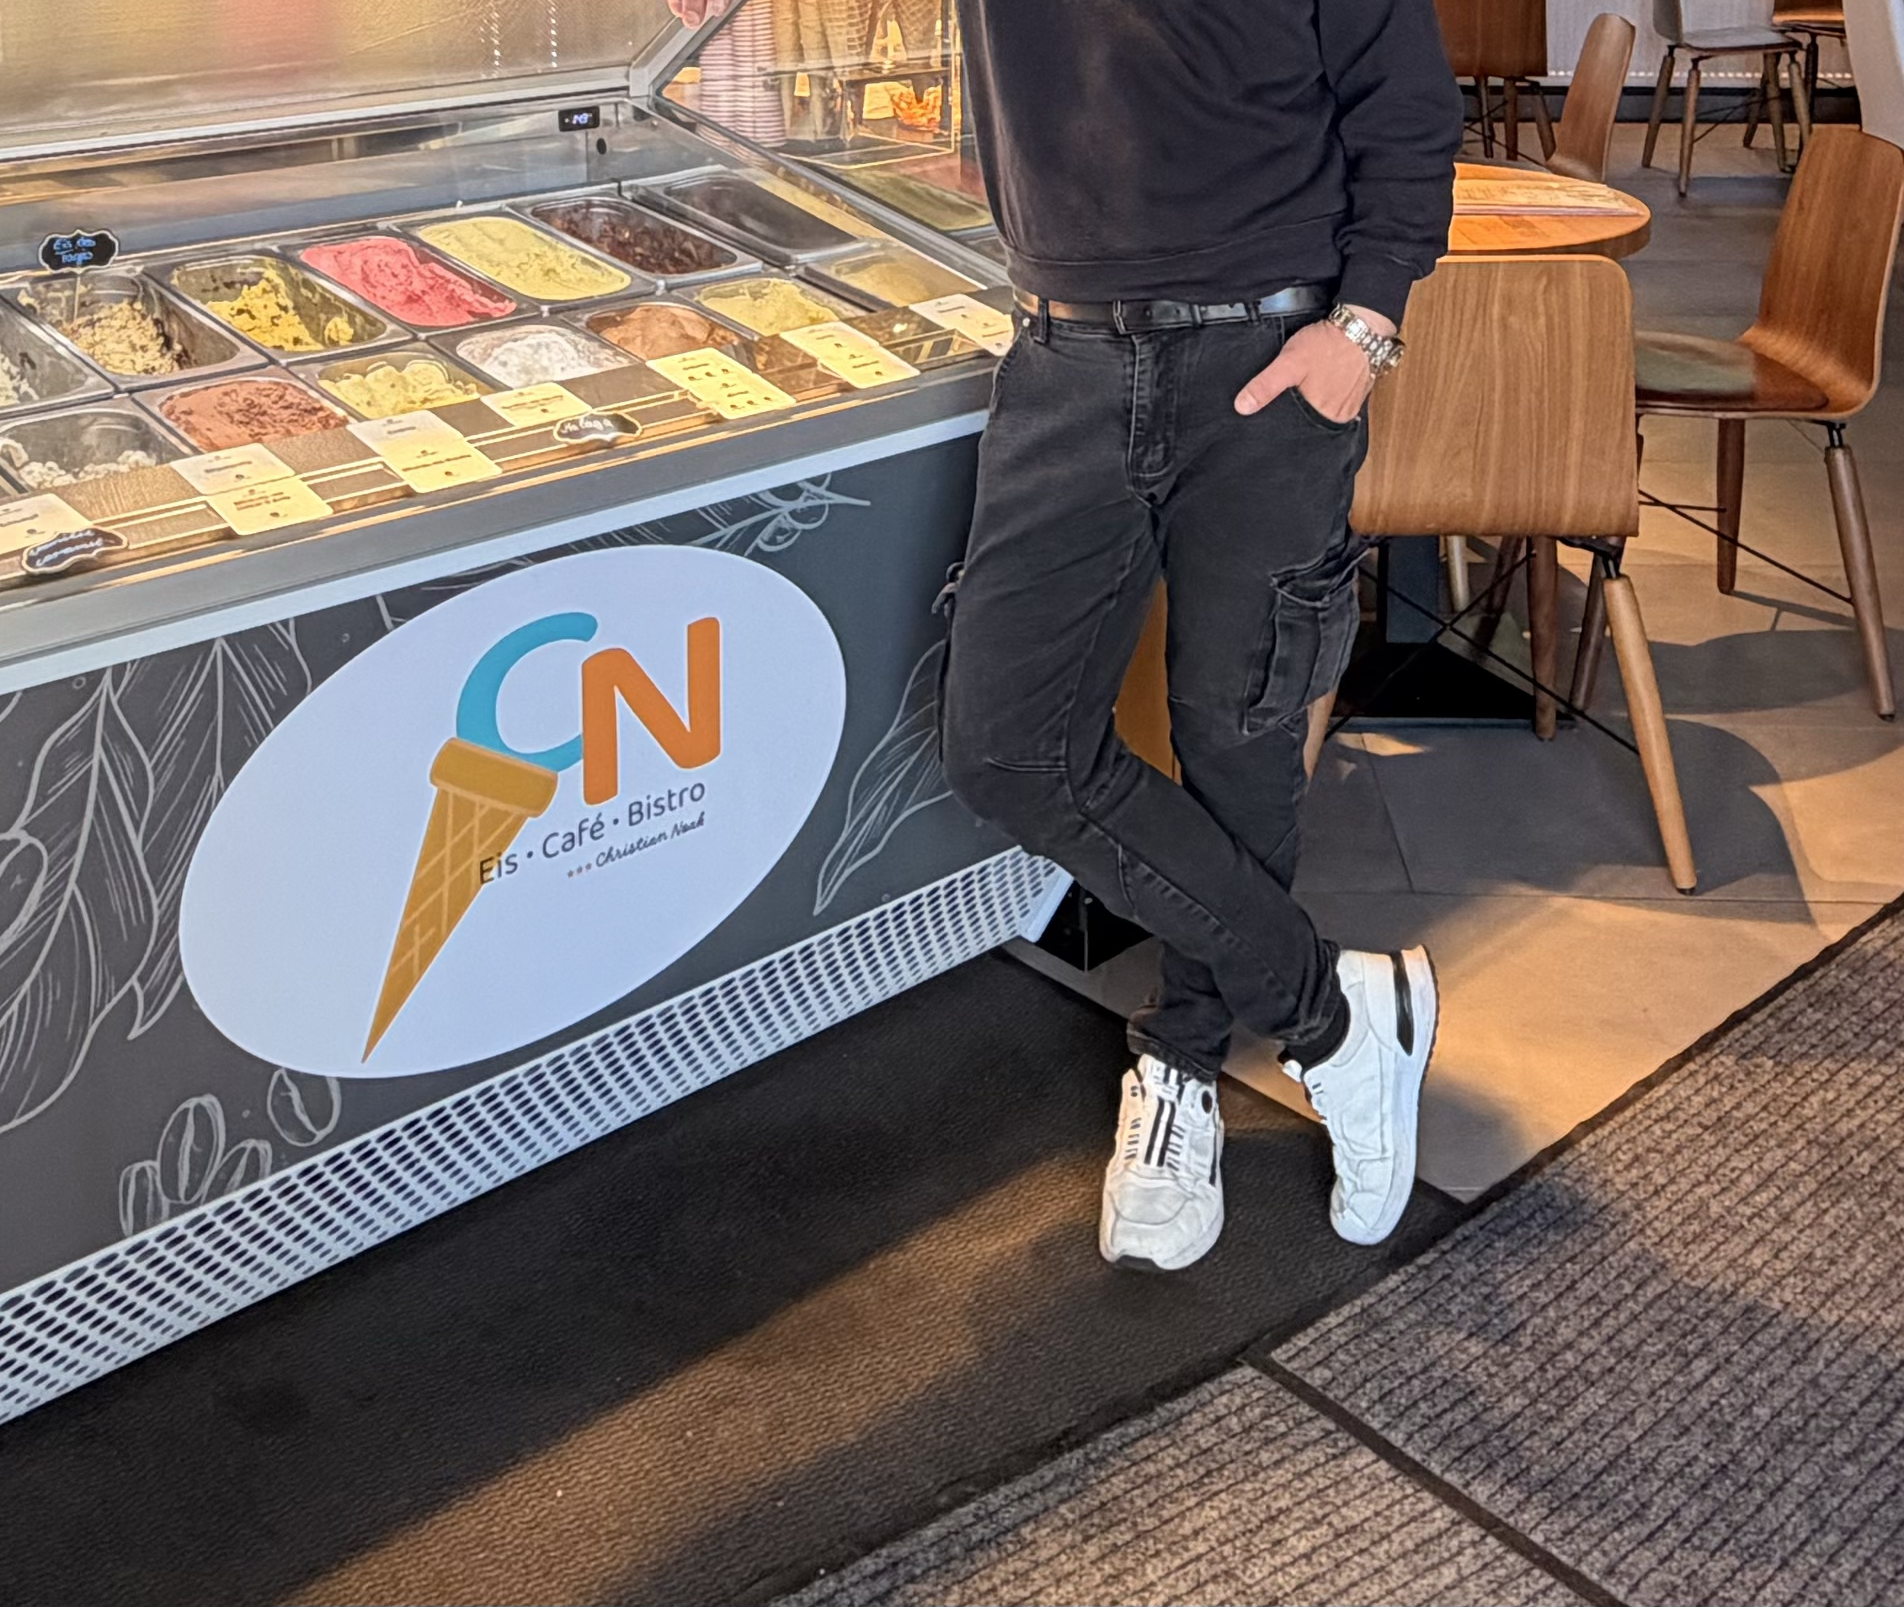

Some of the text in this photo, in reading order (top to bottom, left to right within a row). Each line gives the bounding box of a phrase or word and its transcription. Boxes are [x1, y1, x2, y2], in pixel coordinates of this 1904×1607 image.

[479, 782, 705, 885] Eis Café Bistro
[596, 832, 668, 867] Christian
